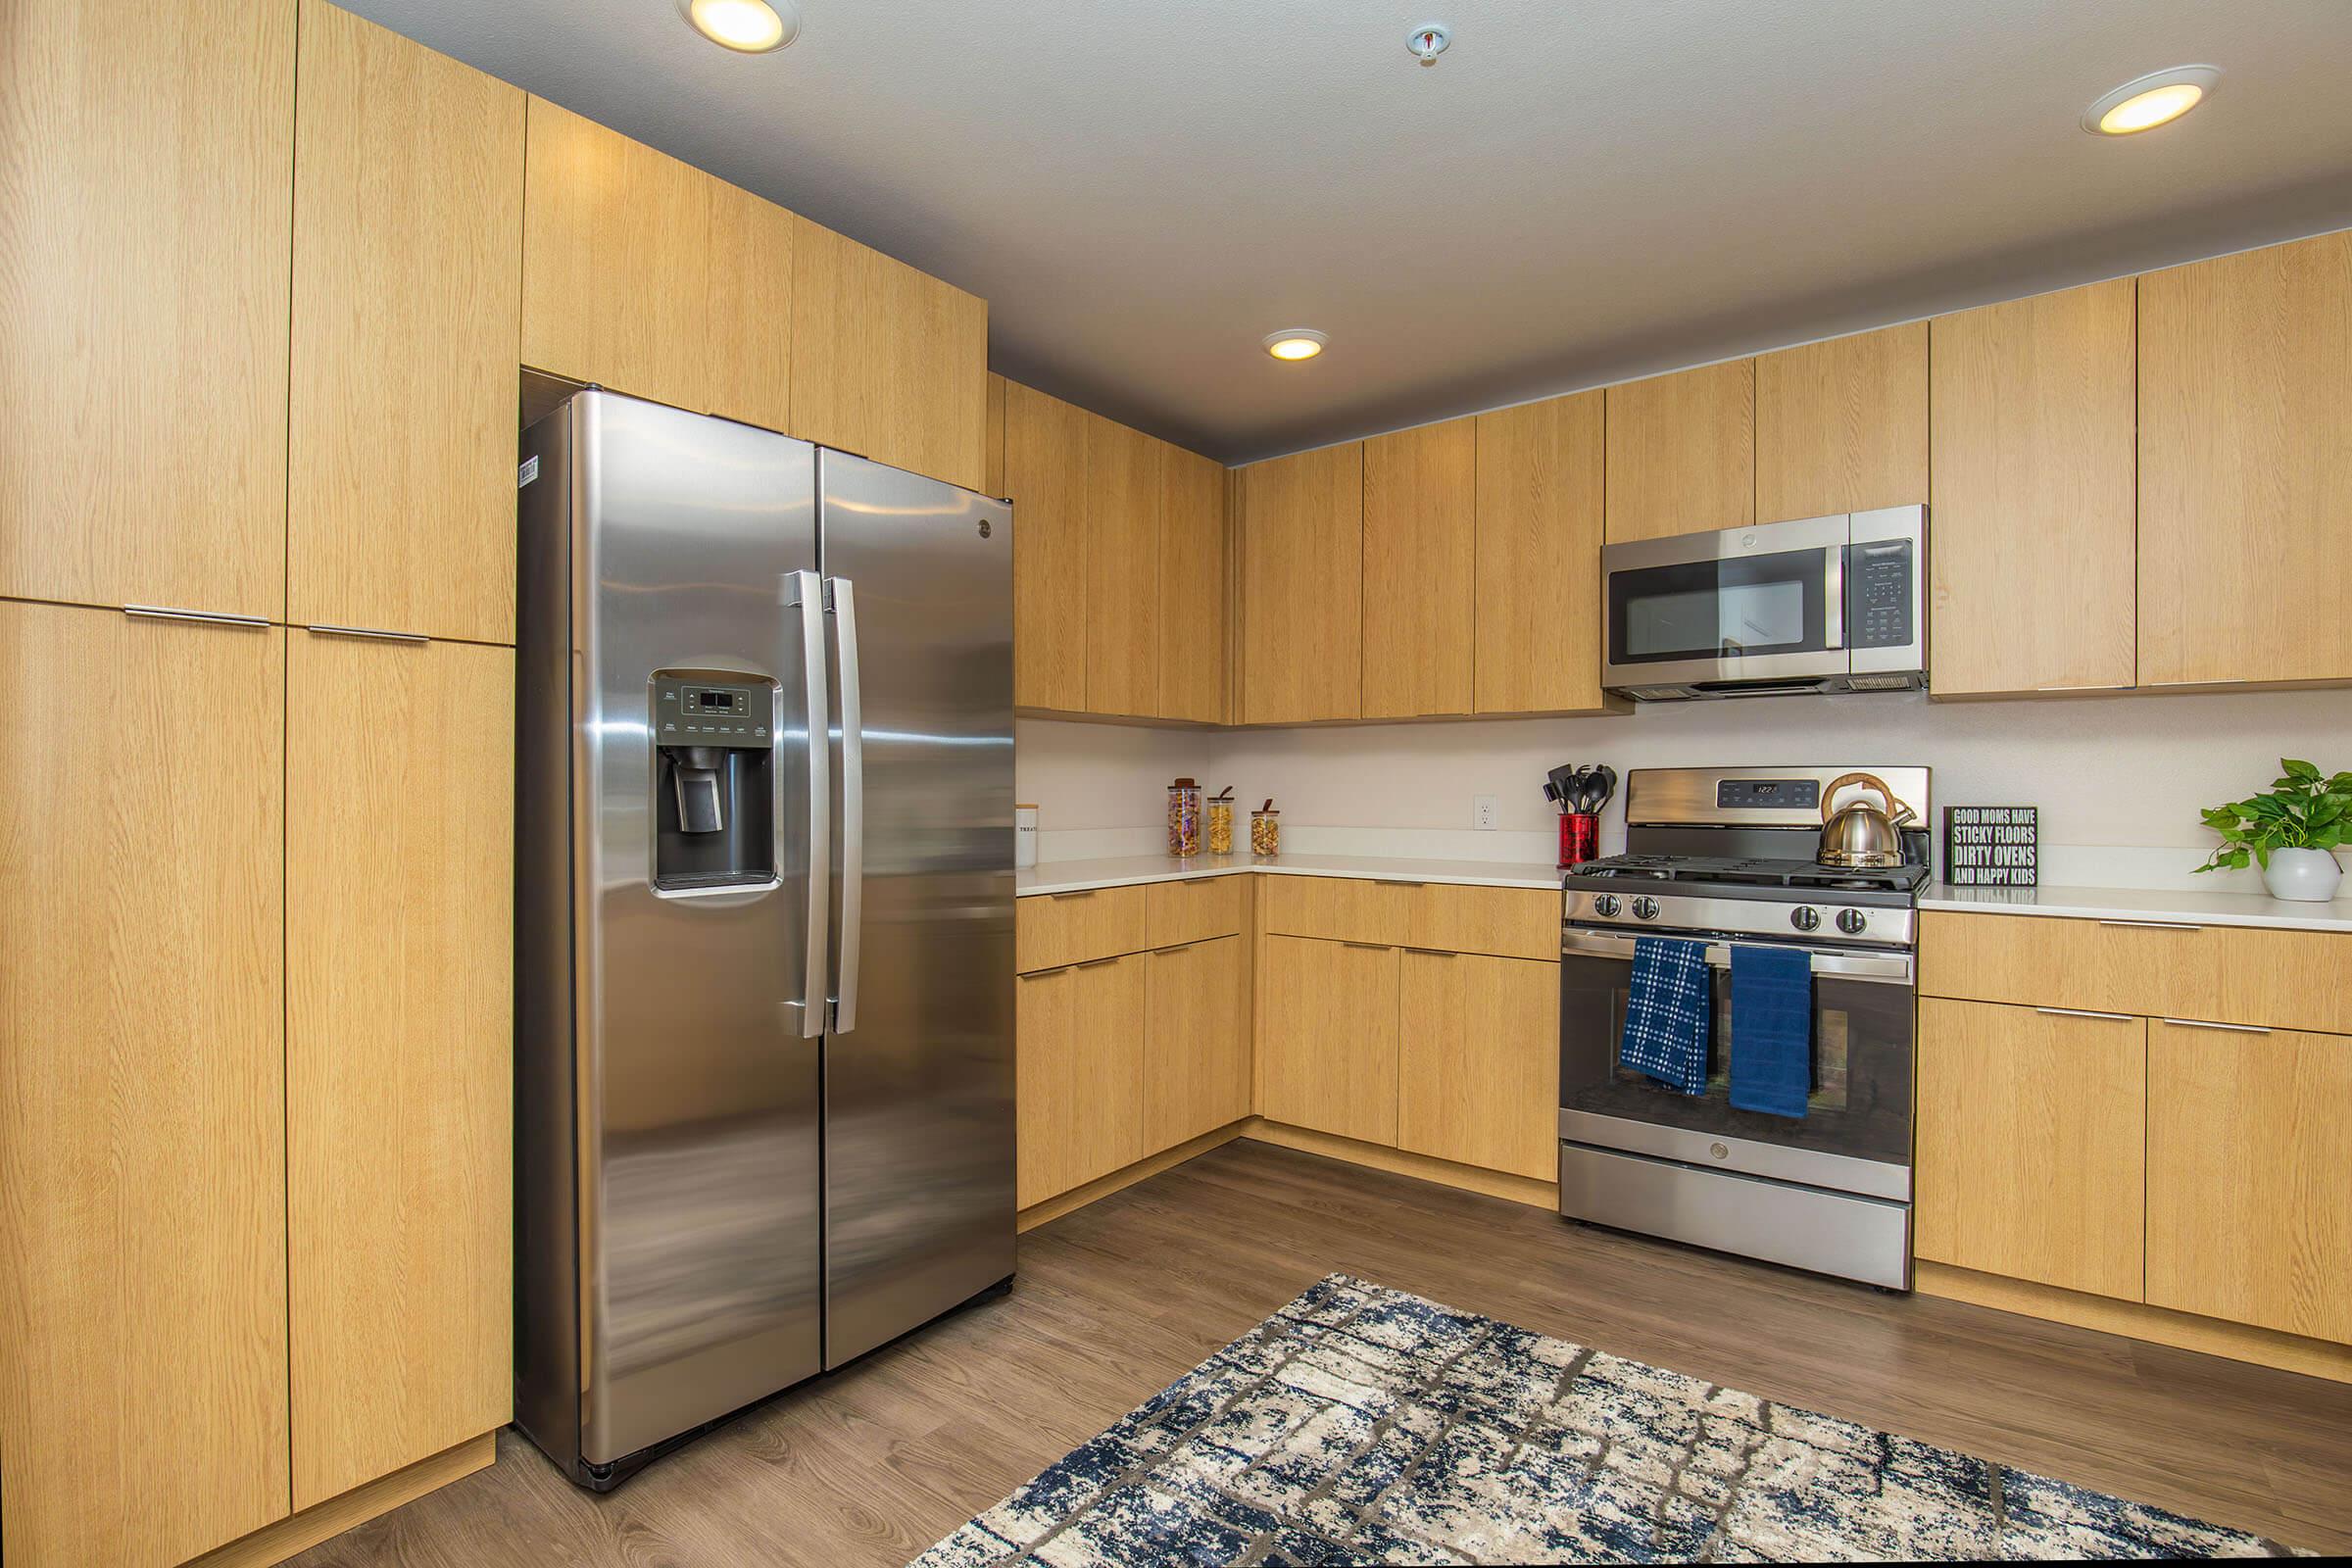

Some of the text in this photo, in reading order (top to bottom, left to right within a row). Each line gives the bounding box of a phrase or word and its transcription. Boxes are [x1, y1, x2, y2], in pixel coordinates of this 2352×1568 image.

[1954, 808, 2035, 824] GOOD MOMS HAVE
[1954, 826, 2035, 844] STICKY FLOORS
[1954, 846, 2035, 866] DIRTY OVENS
[1954, 867, 2035, 884] AND HAPPY KIDS
